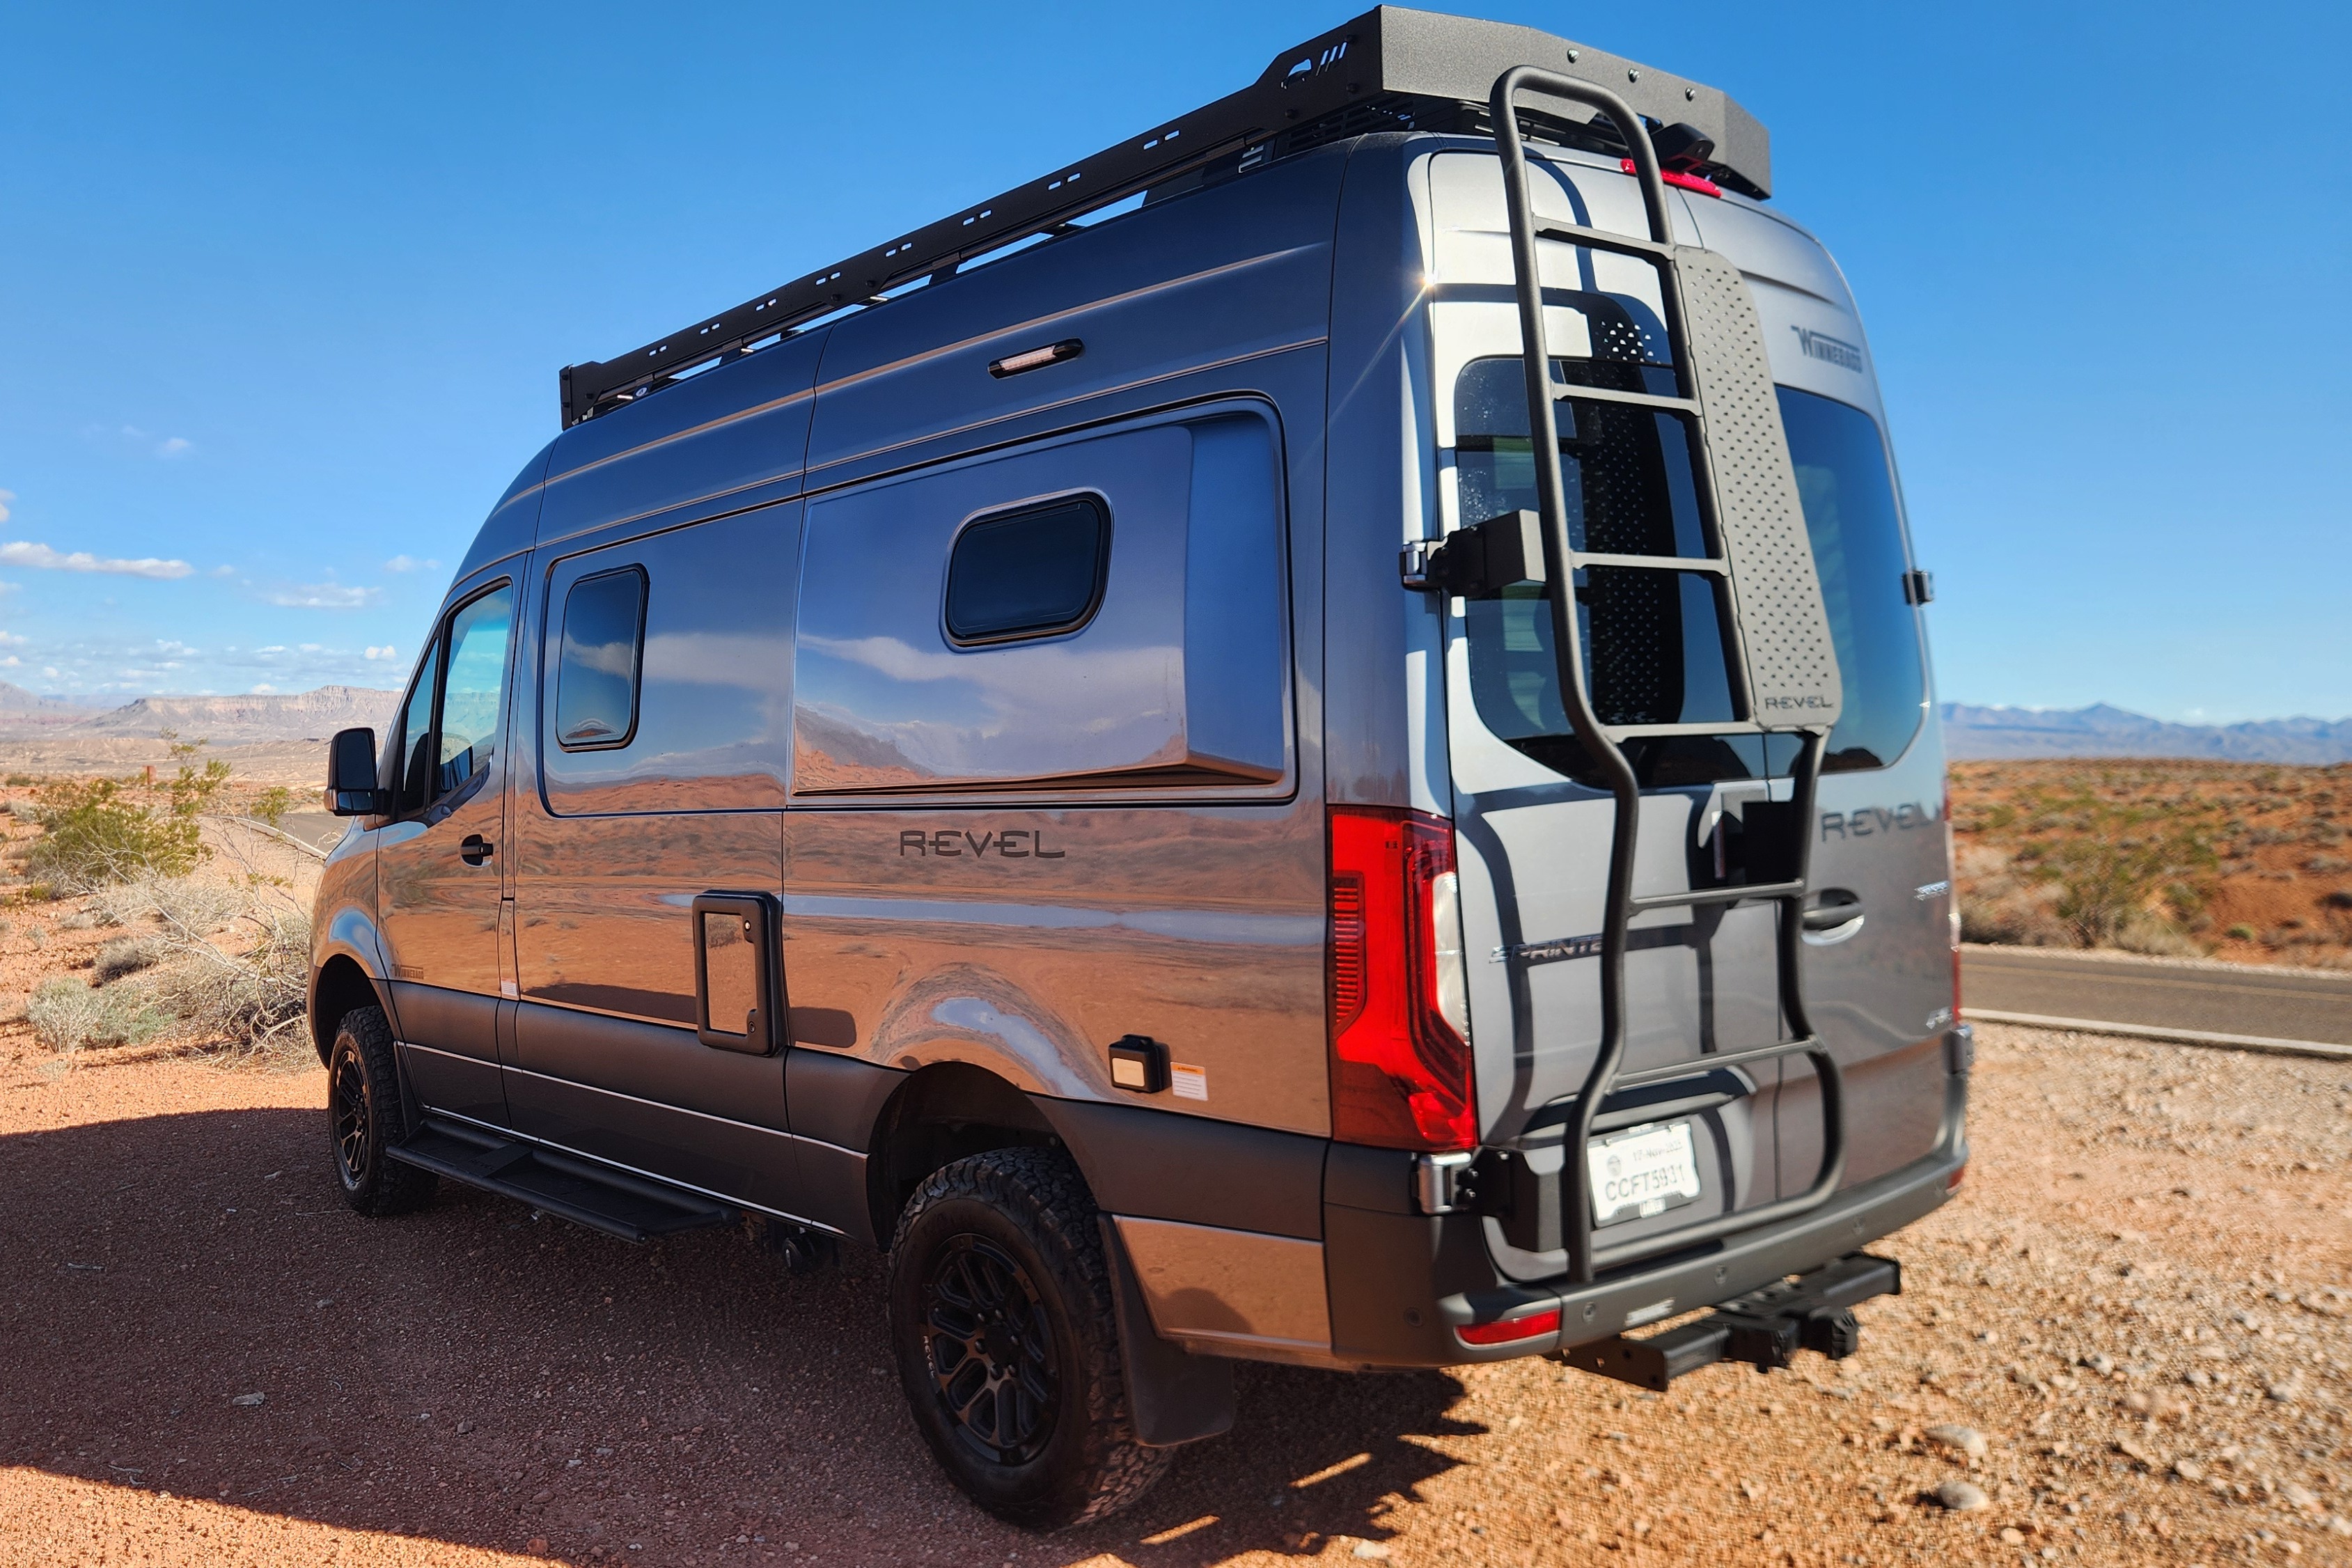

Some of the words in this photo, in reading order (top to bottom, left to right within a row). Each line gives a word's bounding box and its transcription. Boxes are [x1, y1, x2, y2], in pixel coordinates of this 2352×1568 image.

[1764, 696, 1835, 710] REVEL
[1820, 799, 1936, 844] REVEL
[900, 830, 1065, 859] REVEL
[1489, 934, 1603, 964] SPRINTE
[1606, 1163, 1685, 1201] CCFT5931
